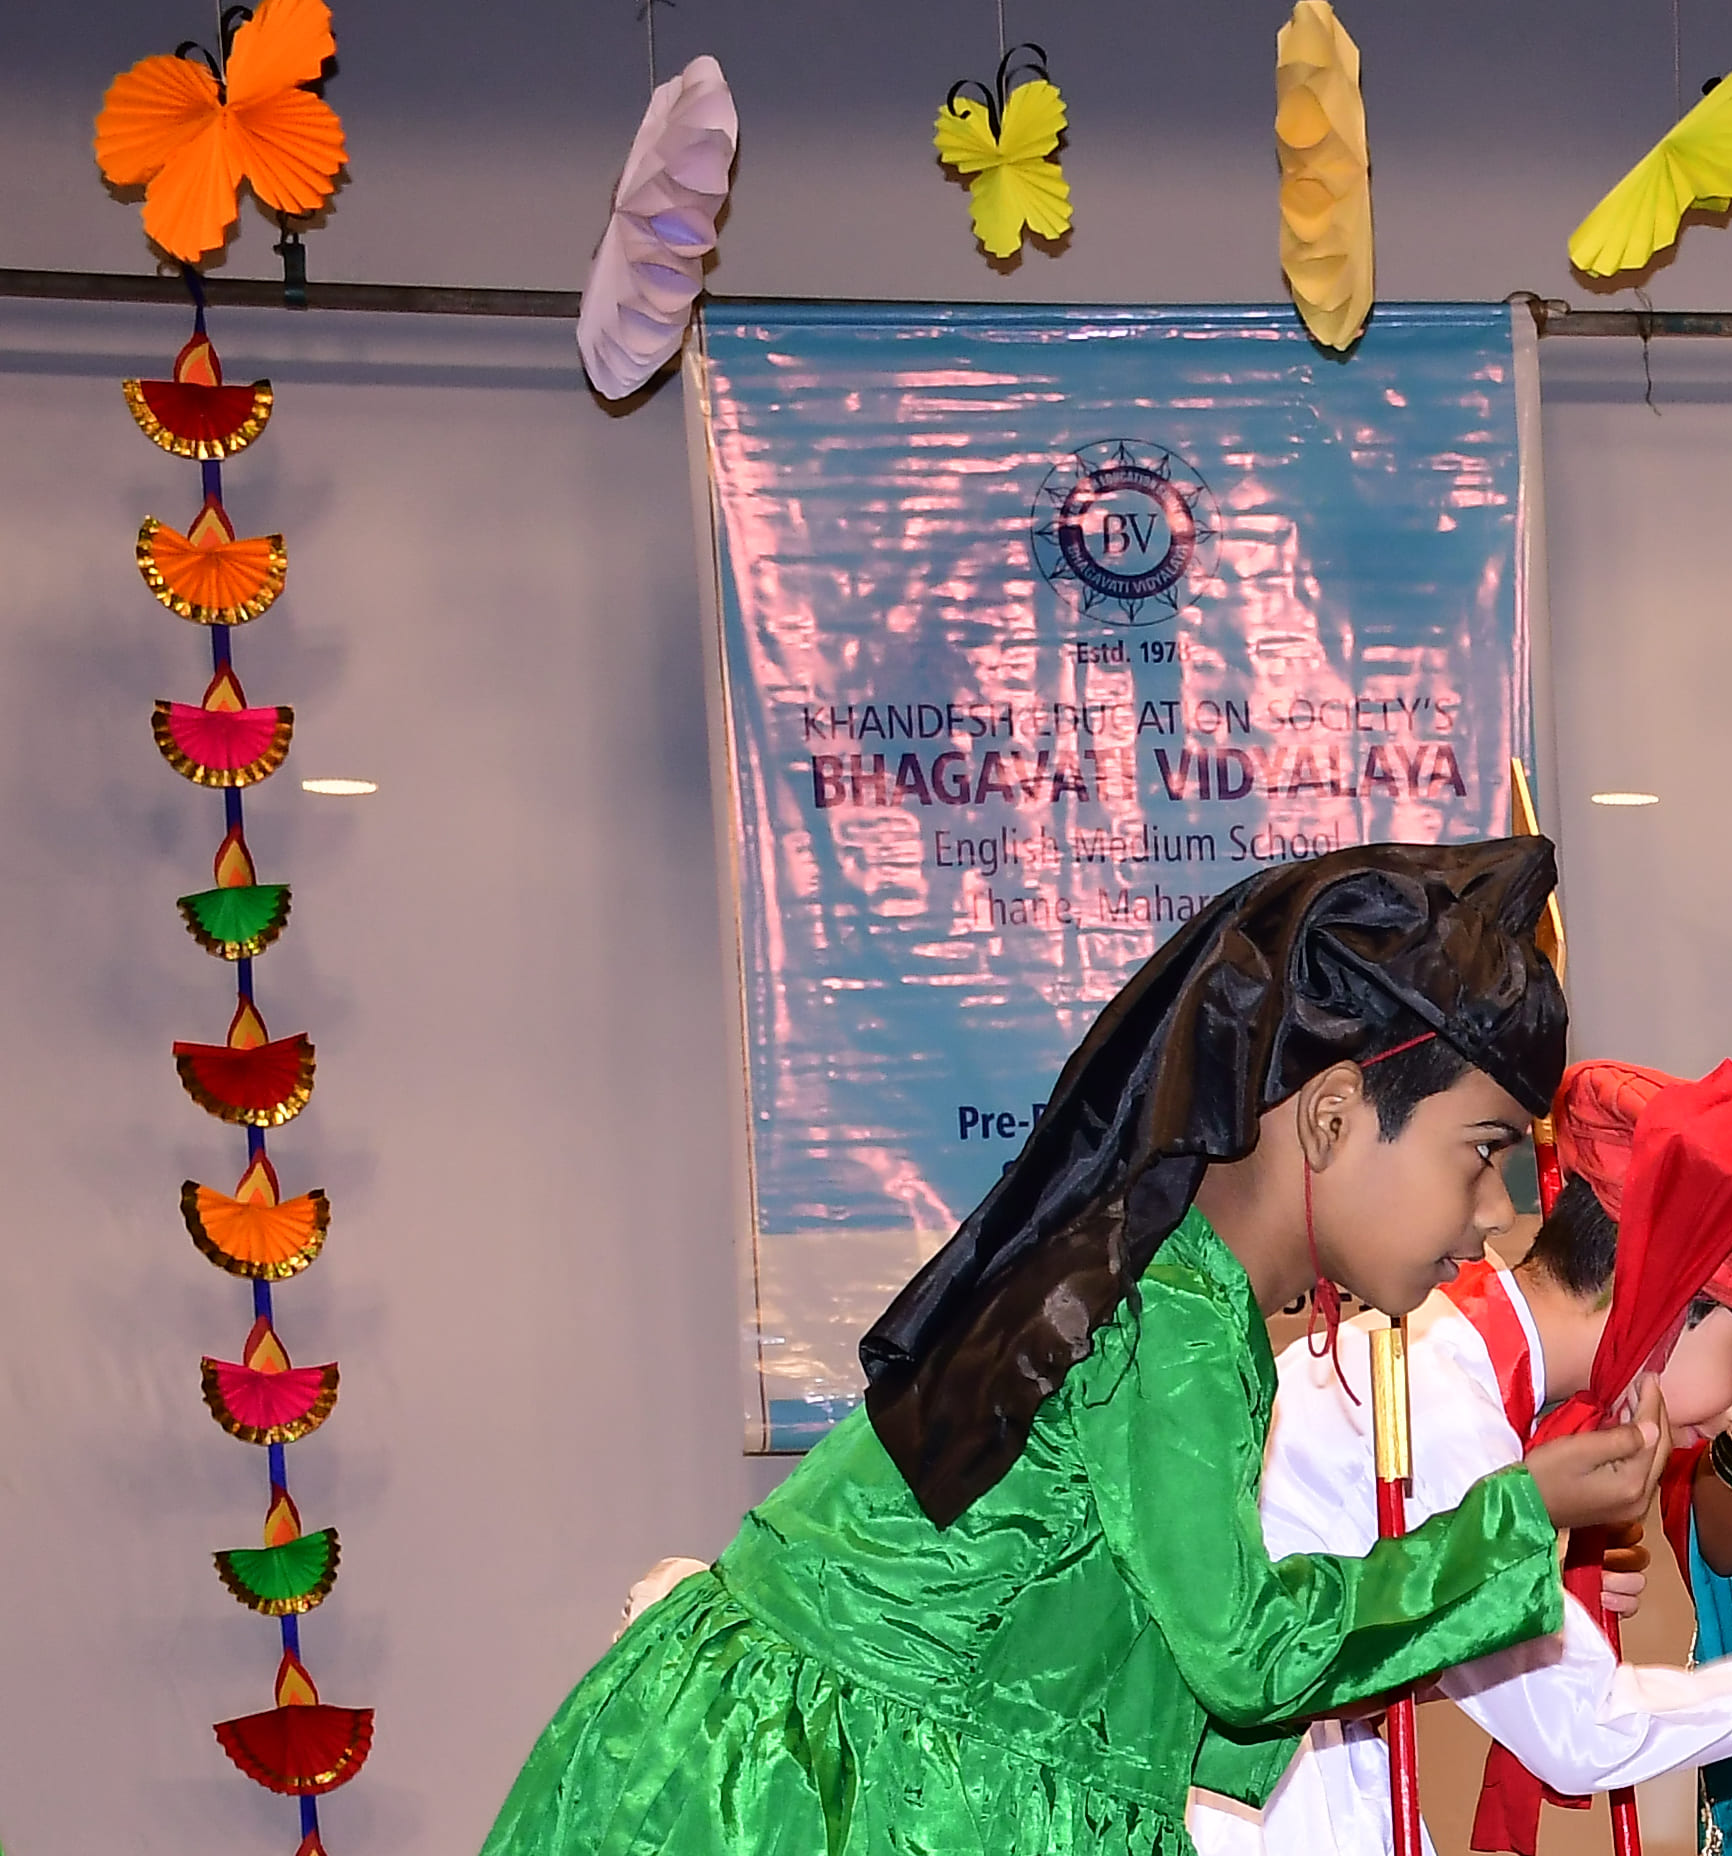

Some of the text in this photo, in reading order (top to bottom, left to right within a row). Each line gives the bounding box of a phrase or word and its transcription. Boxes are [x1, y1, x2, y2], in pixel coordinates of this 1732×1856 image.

[1103, 513, 1158, 554] BV
[1077, 640, 1131, 663] Estd.
[803, 704, 1014, 740] KHANDESH
[1267, 697, 1455, 731] SOCIETY'S
[812, 746, 1467, 808] BHAGAVATI VIDYALAYA
[935, 826, 1058, 876] English
[1075, 825, 1216, 863] Medium
